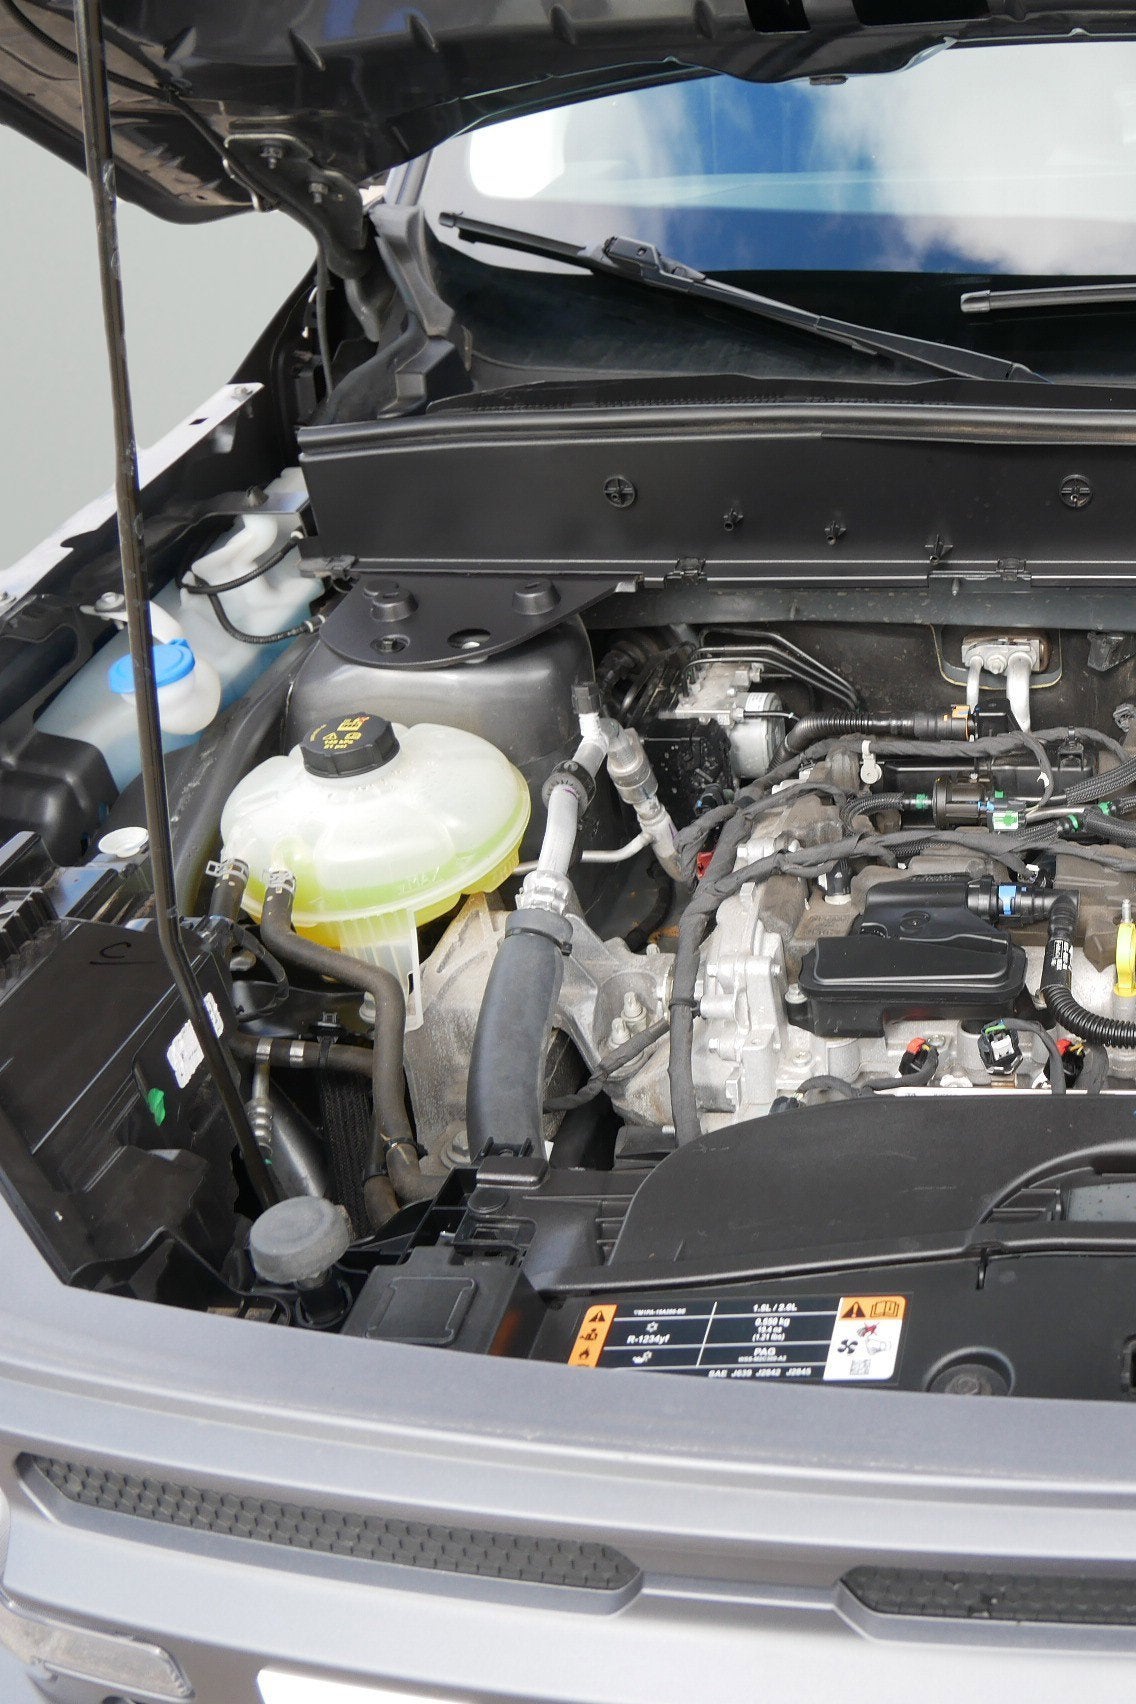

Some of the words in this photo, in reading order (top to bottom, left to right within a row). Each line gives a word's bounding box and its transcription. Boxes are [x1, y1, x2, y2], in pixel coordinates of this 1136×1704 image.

[778, 1316, 791, 1328] kg
[626, 1333, 671, 1345] R-1234yf
[753, 1346, 777, 1357] PAG
[707, 1369, 728, 1378] SAE
[731, 1368, 753, 1378] J639
